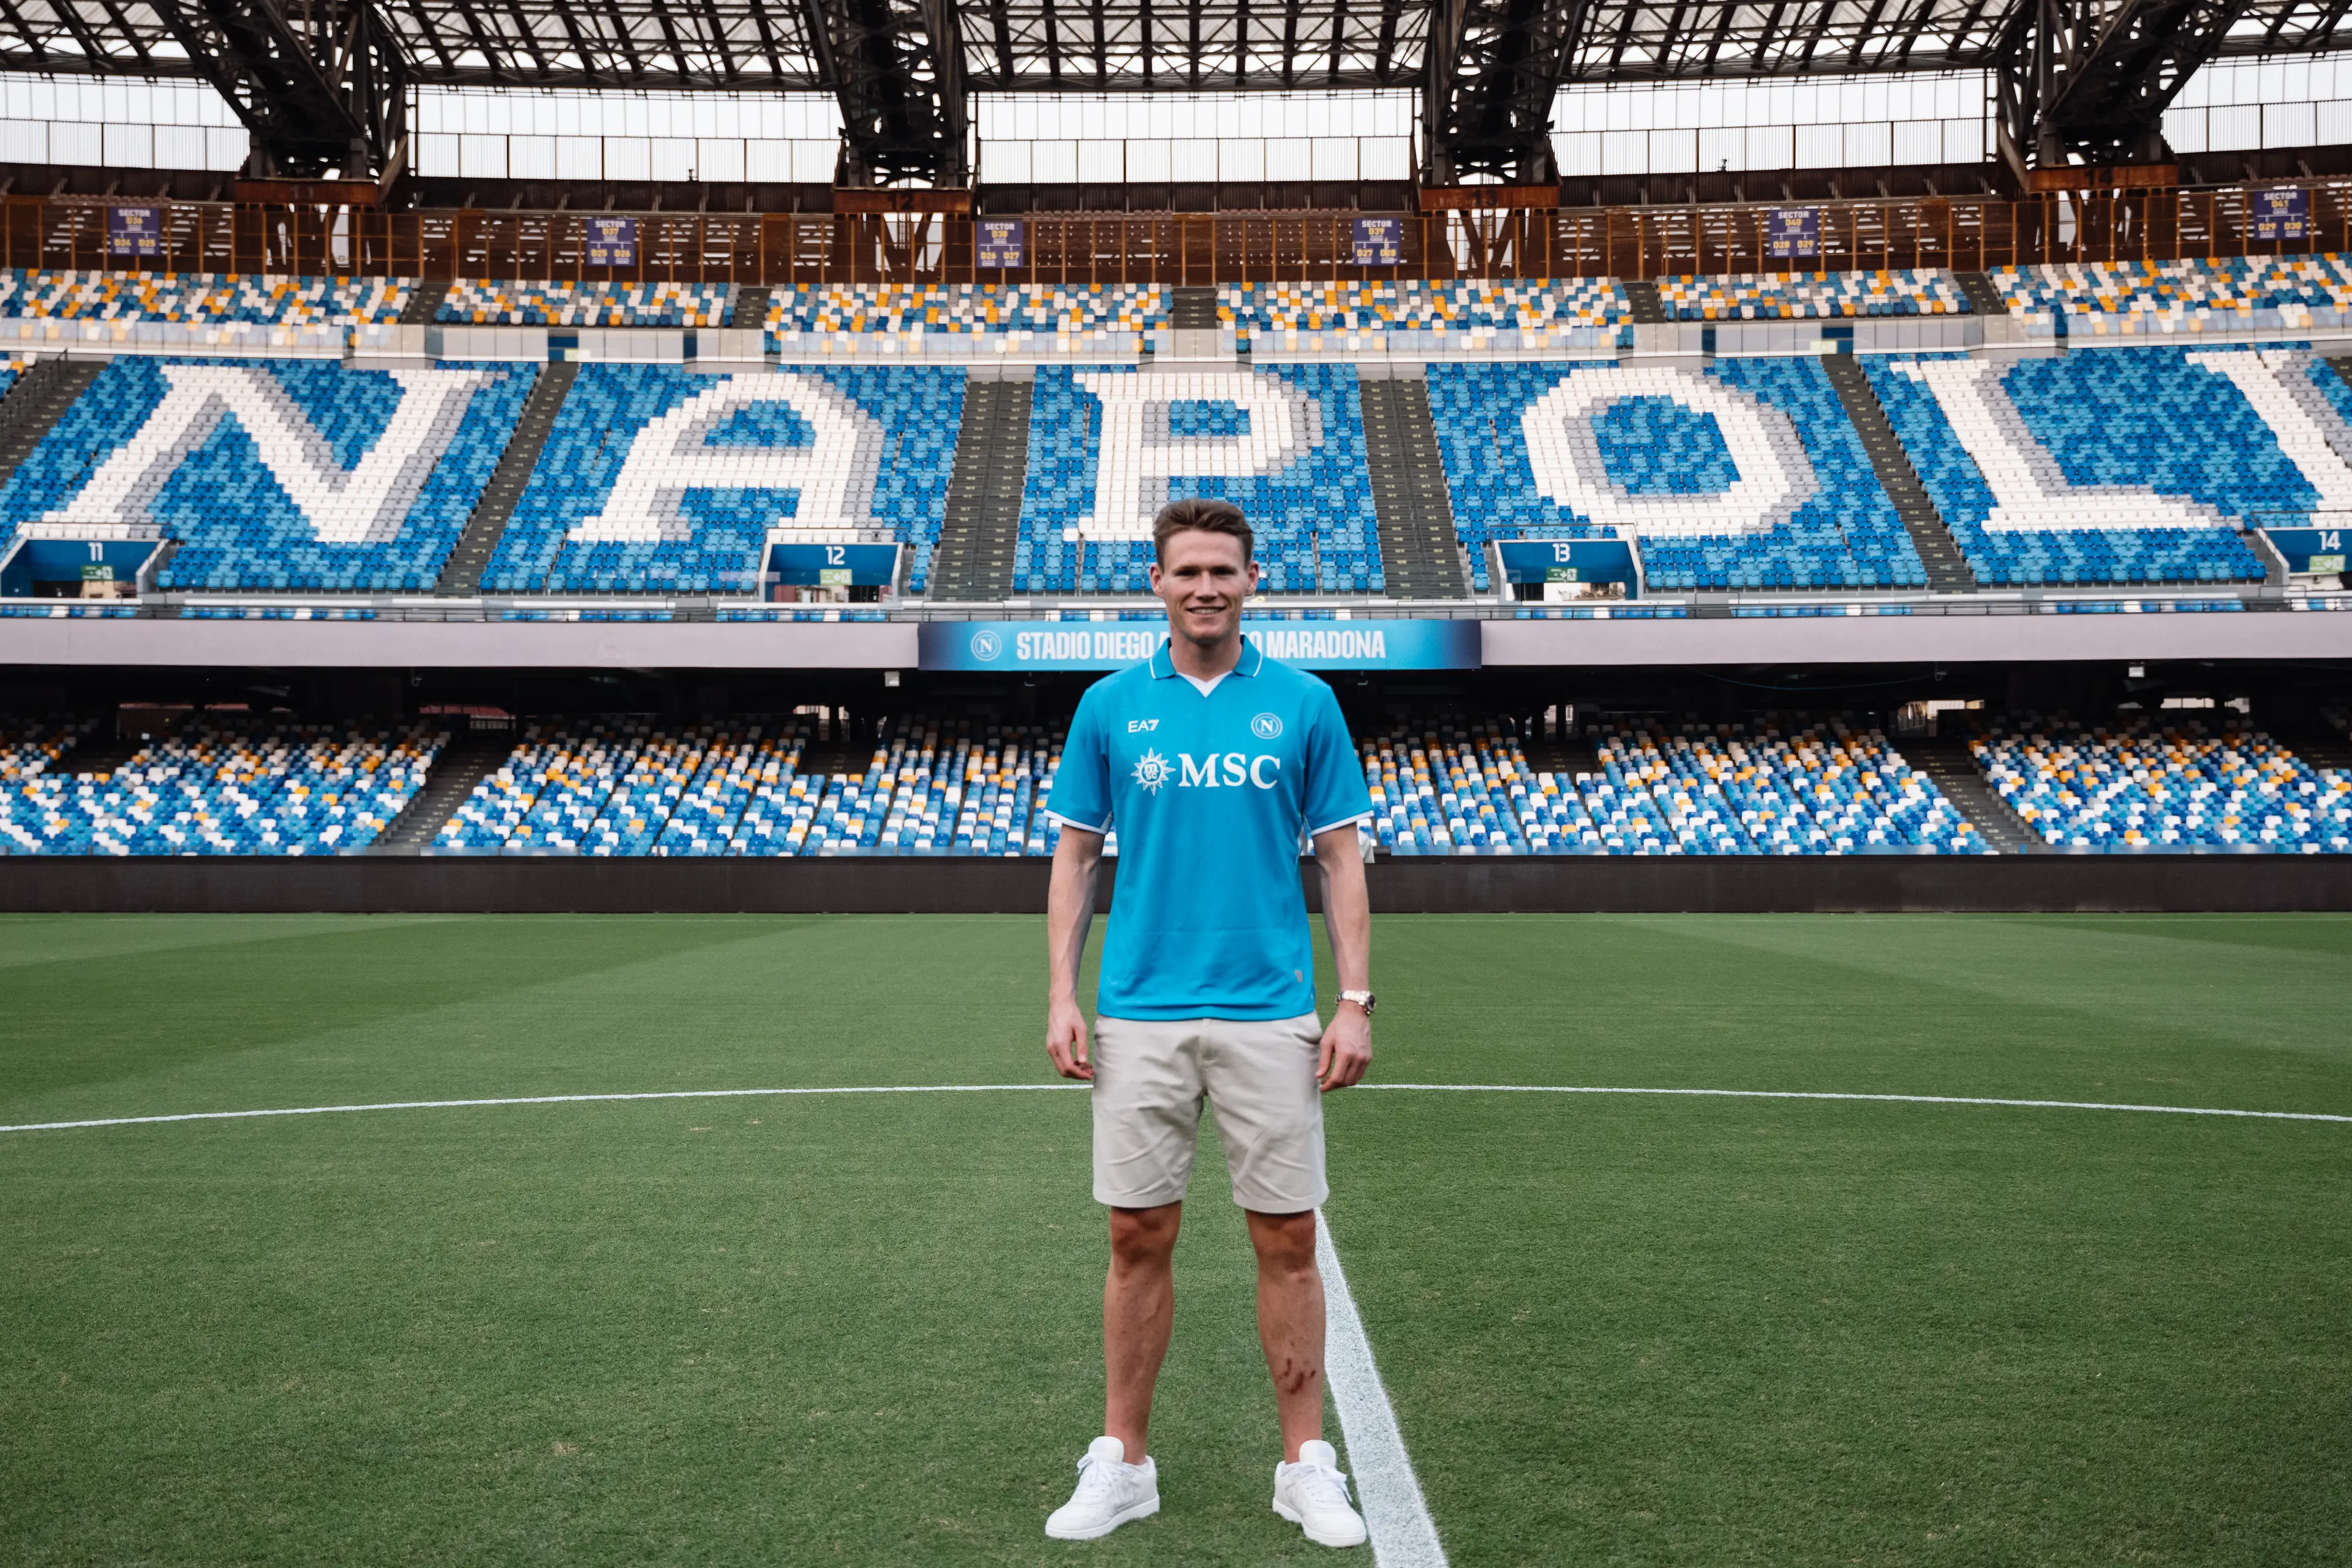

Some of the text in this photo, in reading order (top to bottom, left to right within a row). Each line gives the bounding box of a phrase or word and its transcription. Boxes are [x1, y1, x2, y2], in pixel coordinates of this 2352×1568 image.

[2085, 169, 2113, 186] 14
[887, 191, 914, 210] 12
[2264, 192, 2297, 200] SECTOR
[2318, 531, 2341, 551] 14
[88, 542, 103, 562] 11
[825, 546, 845, 565] 12
[1552, 543, 1570, 562] 13
[1017, 631, 1091, 660] STADIO
[1094, 631, 1154, 659] DIEGO
[1267, 631, 1385, 658] MARADONA
[1128, 719, 1159, 733] EA7
[1177, 752, 1280, 790] MSC
